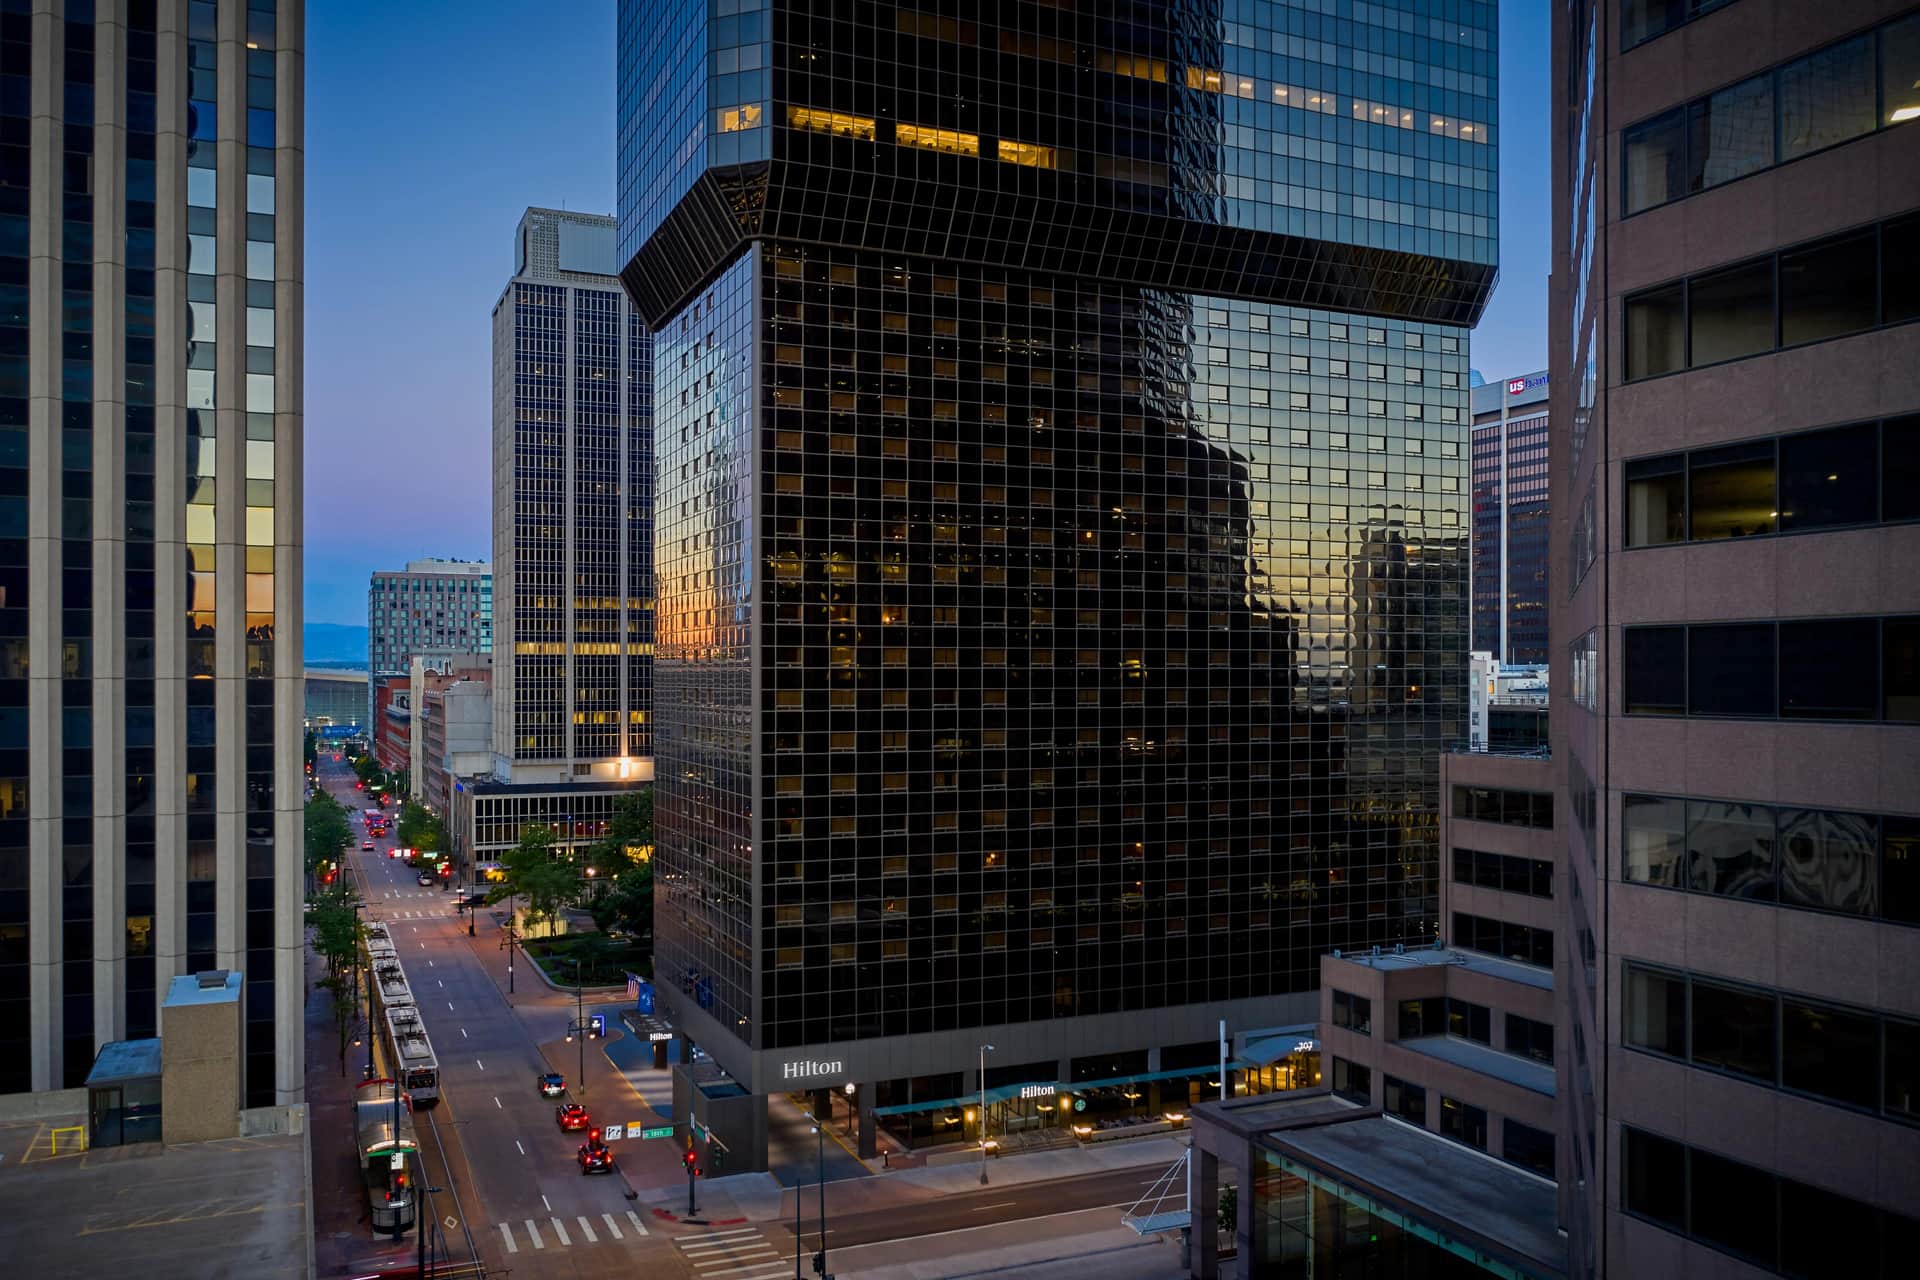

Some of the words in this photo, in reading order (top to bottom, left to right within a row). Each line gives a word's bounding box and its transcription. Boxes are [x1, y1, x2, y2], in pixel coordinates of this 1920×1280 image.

[649, 1031, 673, 1041] Hilton
[783, 1058, 843, 1079] Hilton
[1020, 1084, 1055, 1099] Hilton
